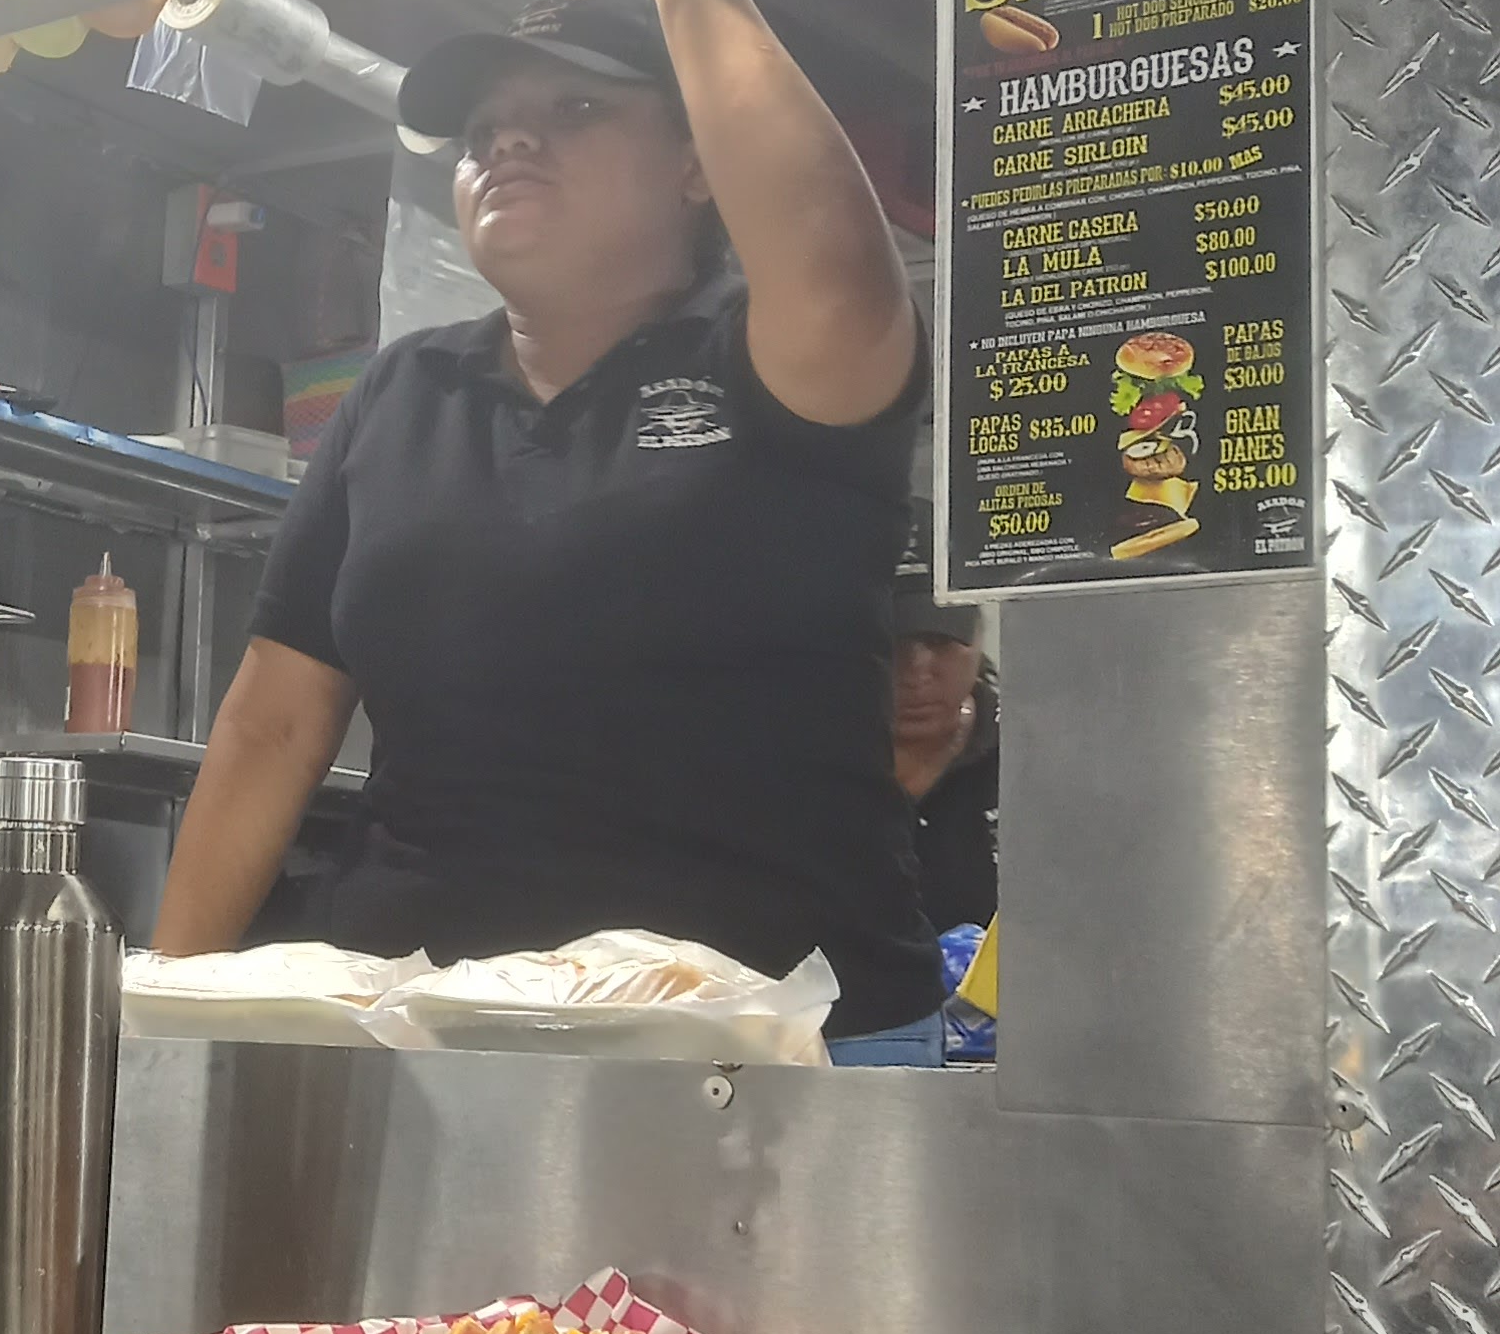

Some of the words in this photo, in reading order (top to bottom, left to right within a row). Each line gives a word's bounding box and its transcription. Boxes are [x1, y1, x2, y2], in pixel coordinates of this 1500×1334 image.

[1093, 12, 1102, 39] 1
[1109, 20, 1130, 38] HOT
[1135, 16, 1159, 34] DOG
[1162, 0, 1235, 27] PREPARADO
[1116, 3, 1139, 18] HOT
[1000, 37, 1254, 116] HAMBURGUESAS
[993, 117, 1053, 145] CARNE
[1061, 96, 1170, 134] ARRACHERA
[1219, 74, 1291, 106] $45.00
[993, 149, 1053, 177] CARNE
[1064, 134, 1148, 166] SIRLOIN
[1222, 107, 1294, 139] $45.00
[971, 190, 1010, 210] PUEDES
[1013, 182, 1063, 204] PEDIRLAS
[1065, 169, 1138, 196] PREPARADAS
[1169, 157, 1223, 179] $10.00
[1228, 145, 1263, 170] MAS
[1003, 221, 1064, 250] CARNE
[1068, 210, 1139, 240] CASERA
[1194, 195, 1260, 222] $50.00
[1003, 256, 1030, 279] LA
[1042, 246, 1102, 273] MULA
[1195, 226, 1255, 254] $80.00
[1001, 288, 1026, 308] LA
[1031, 283, 1065, 304] DEL
[1070, 271, 1148, 299] PATRON
[1205, 252, 1276, 281] $100.00
[981, 337, 996, 349] NO
[997, 330, 1046, 347] INCLUYEN
[1047, 327, 1077, 341] PAPA
[1078, 321, 1125, 337] NINGUNA
[1126, 311, 1206, 333] HAMBURGUESA
[1223, 319, 1284, 345] PAPAS
[975, 365, 997, 378] LA
[1002, 353, 1090, 375] FRANCESA
[995, 345, 1052, 364] PAPAS
[1058, 343, 1071, 356] A
[1227, 347, 1242, 363] DE
[1224, 362, 1285, 393] $30.00
[970, 414, 1022, 436] PAPAS
[1029, 414, 1097, 440] $35.00
[1226, 404, 1280, 434] GRAN
[969, 433, 1019, 454] LOCAS
[1220, 433, 1285, 464] DANES
[995, 483, 1030, 497] ORDEN
[1032, 481, 1046, 494] DE
[1214, 462, 1297, 493] $35.00
[978, 497, 1015, 512] ALITAS
[1017, 493, 1063, 508] PICOSAS
[989, 510, 1050, 539] $50.00
